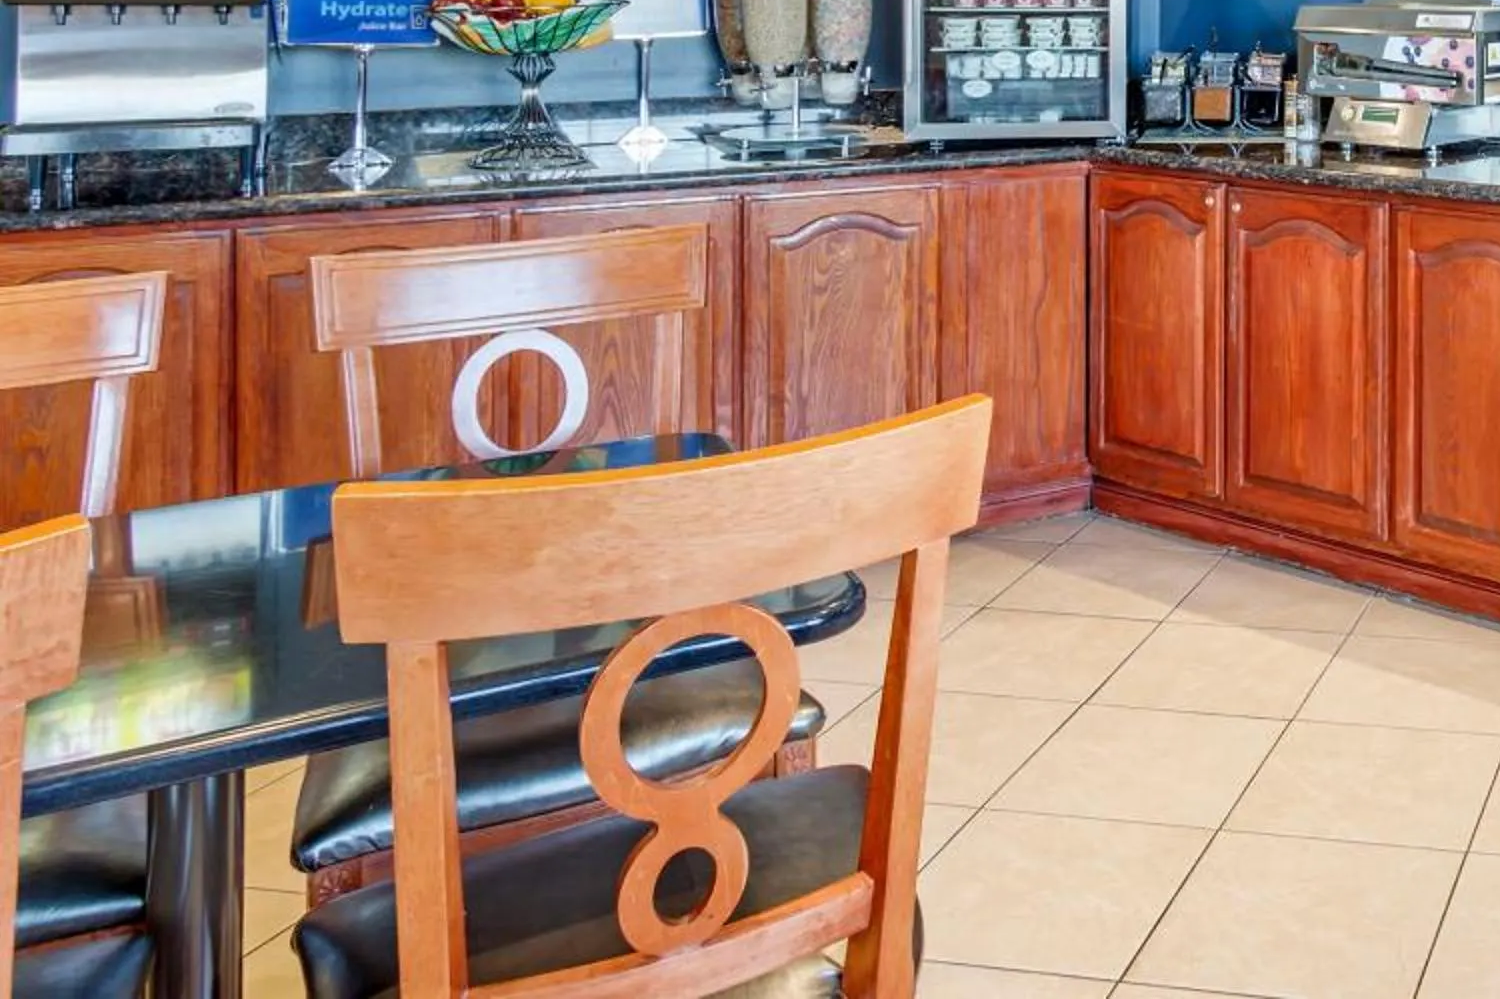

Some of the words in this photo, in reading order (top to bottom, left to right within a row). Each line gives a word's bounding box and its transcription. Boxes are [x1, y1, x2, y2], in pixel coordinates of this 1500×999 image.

[320, 0, 410, 21] Hydrate
[357, 21, 387, 32] Juice
[389, 21, 408, 31] Bar
